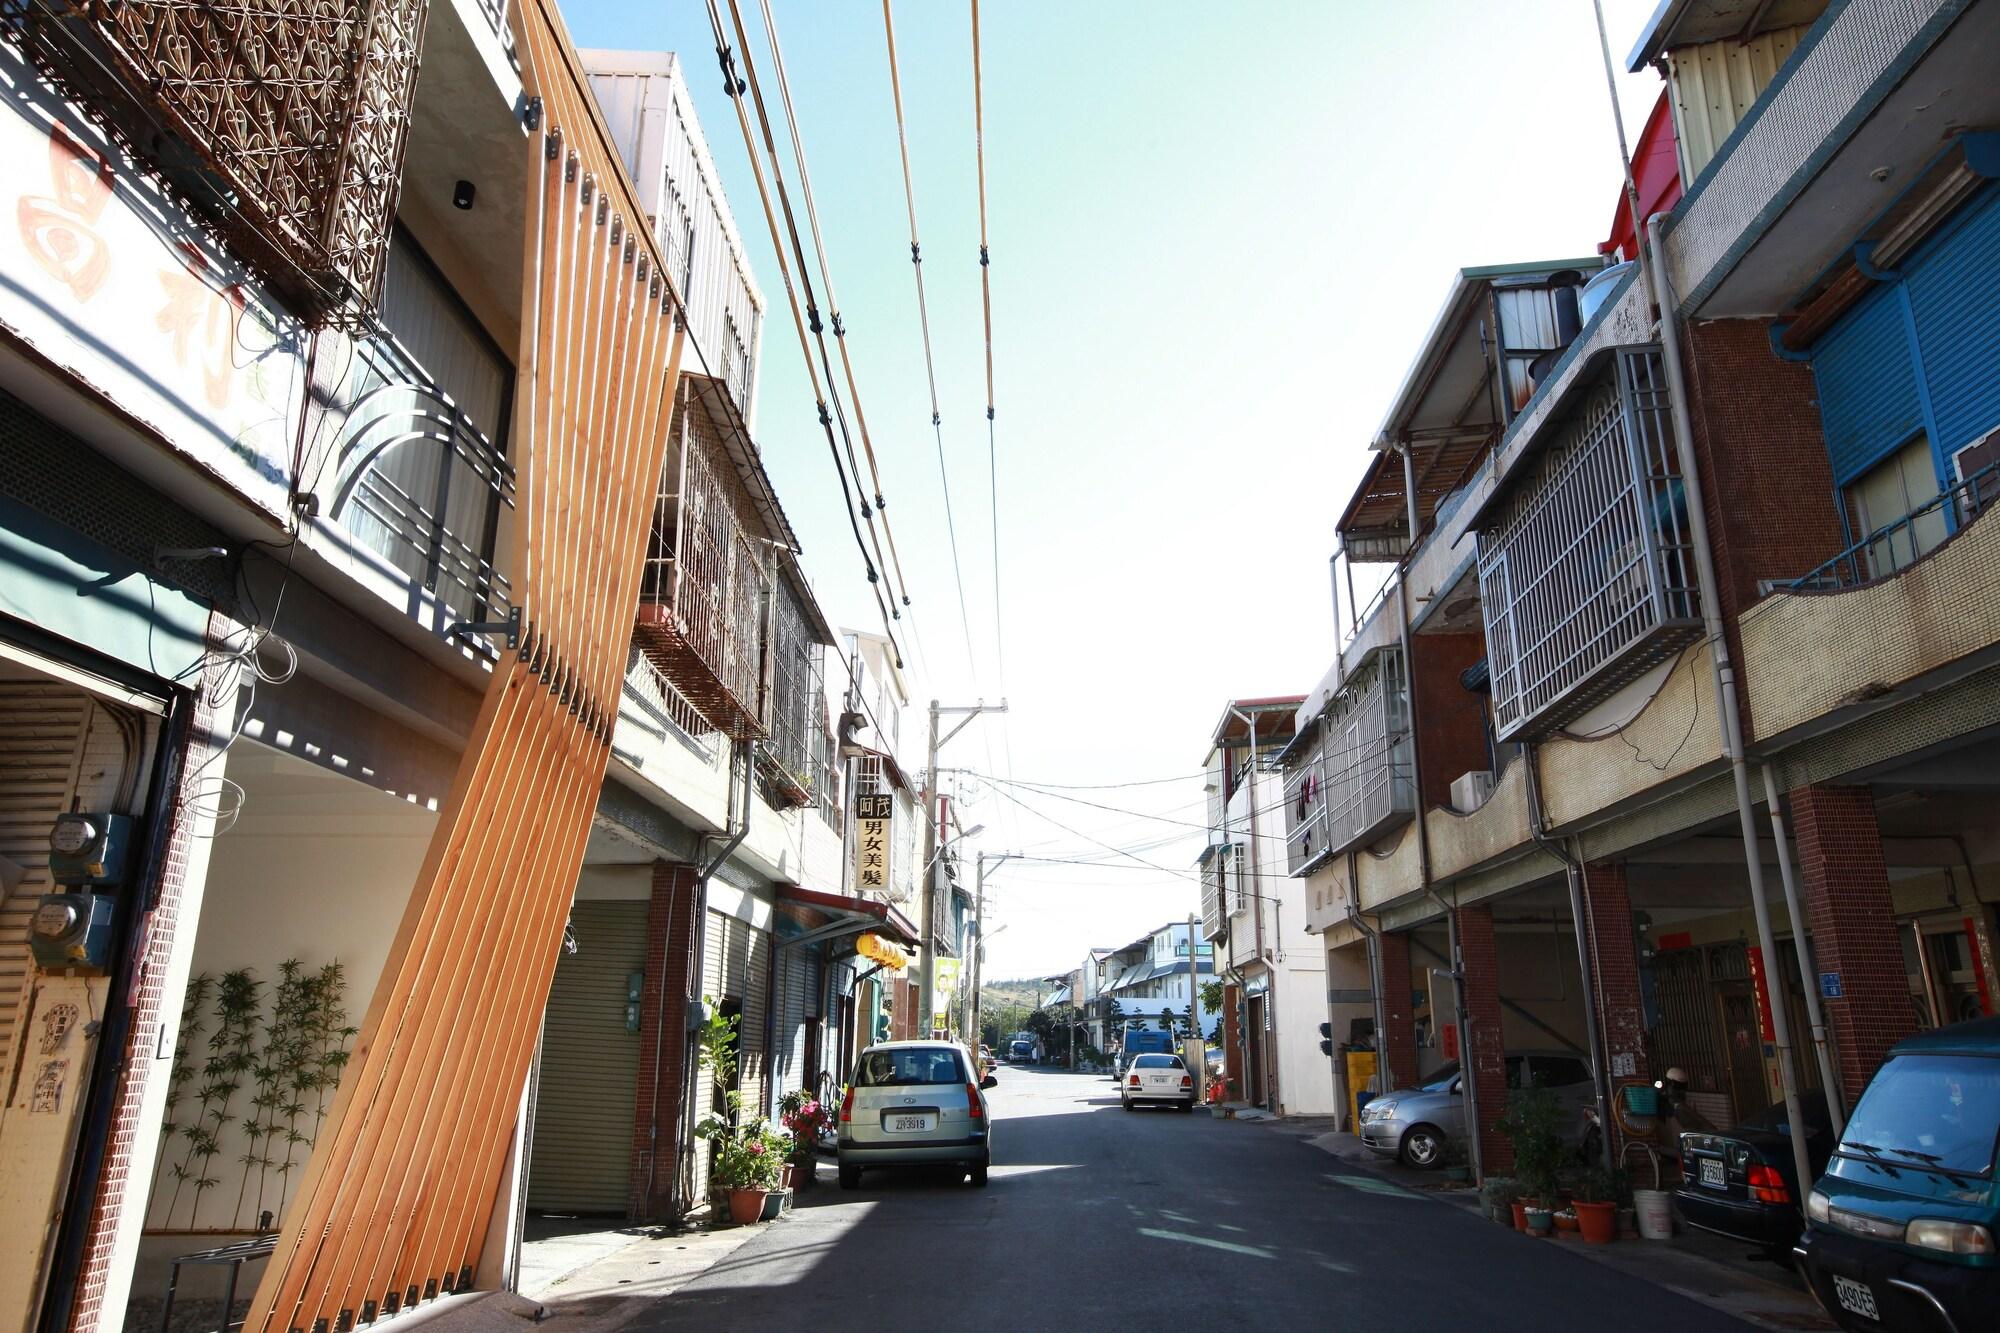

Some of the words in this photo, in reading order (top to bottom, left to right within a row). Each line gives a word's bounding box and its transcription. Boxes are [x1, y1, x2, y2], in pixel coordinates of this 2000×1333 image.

[859, 796, 891, 817] 阿茂
[862, 820, 883, 886] 男女美髮
